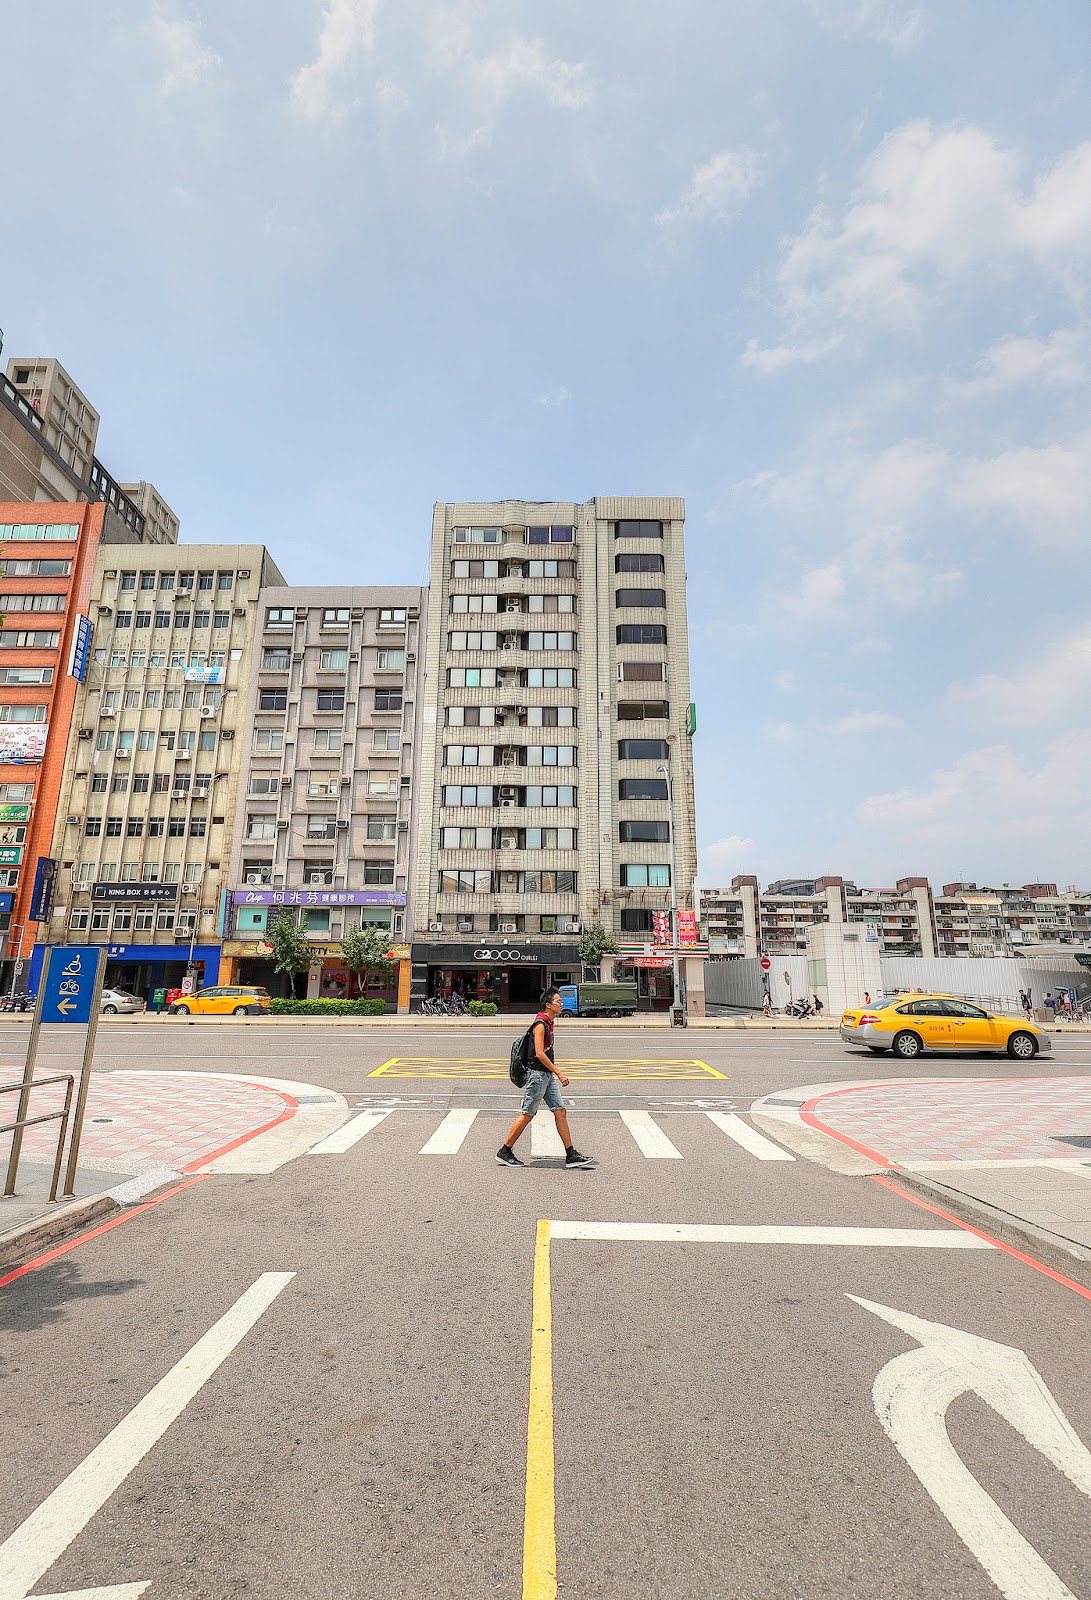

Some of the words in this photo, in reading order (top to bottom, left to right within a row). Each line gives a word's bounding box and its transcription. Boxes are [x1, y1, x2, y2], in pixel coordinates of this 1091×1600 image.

[272, 891, 320, 904] 何兆芬
[321, 893, 356, 903] 健康診所
[473, 949, 521, 961] G2000
